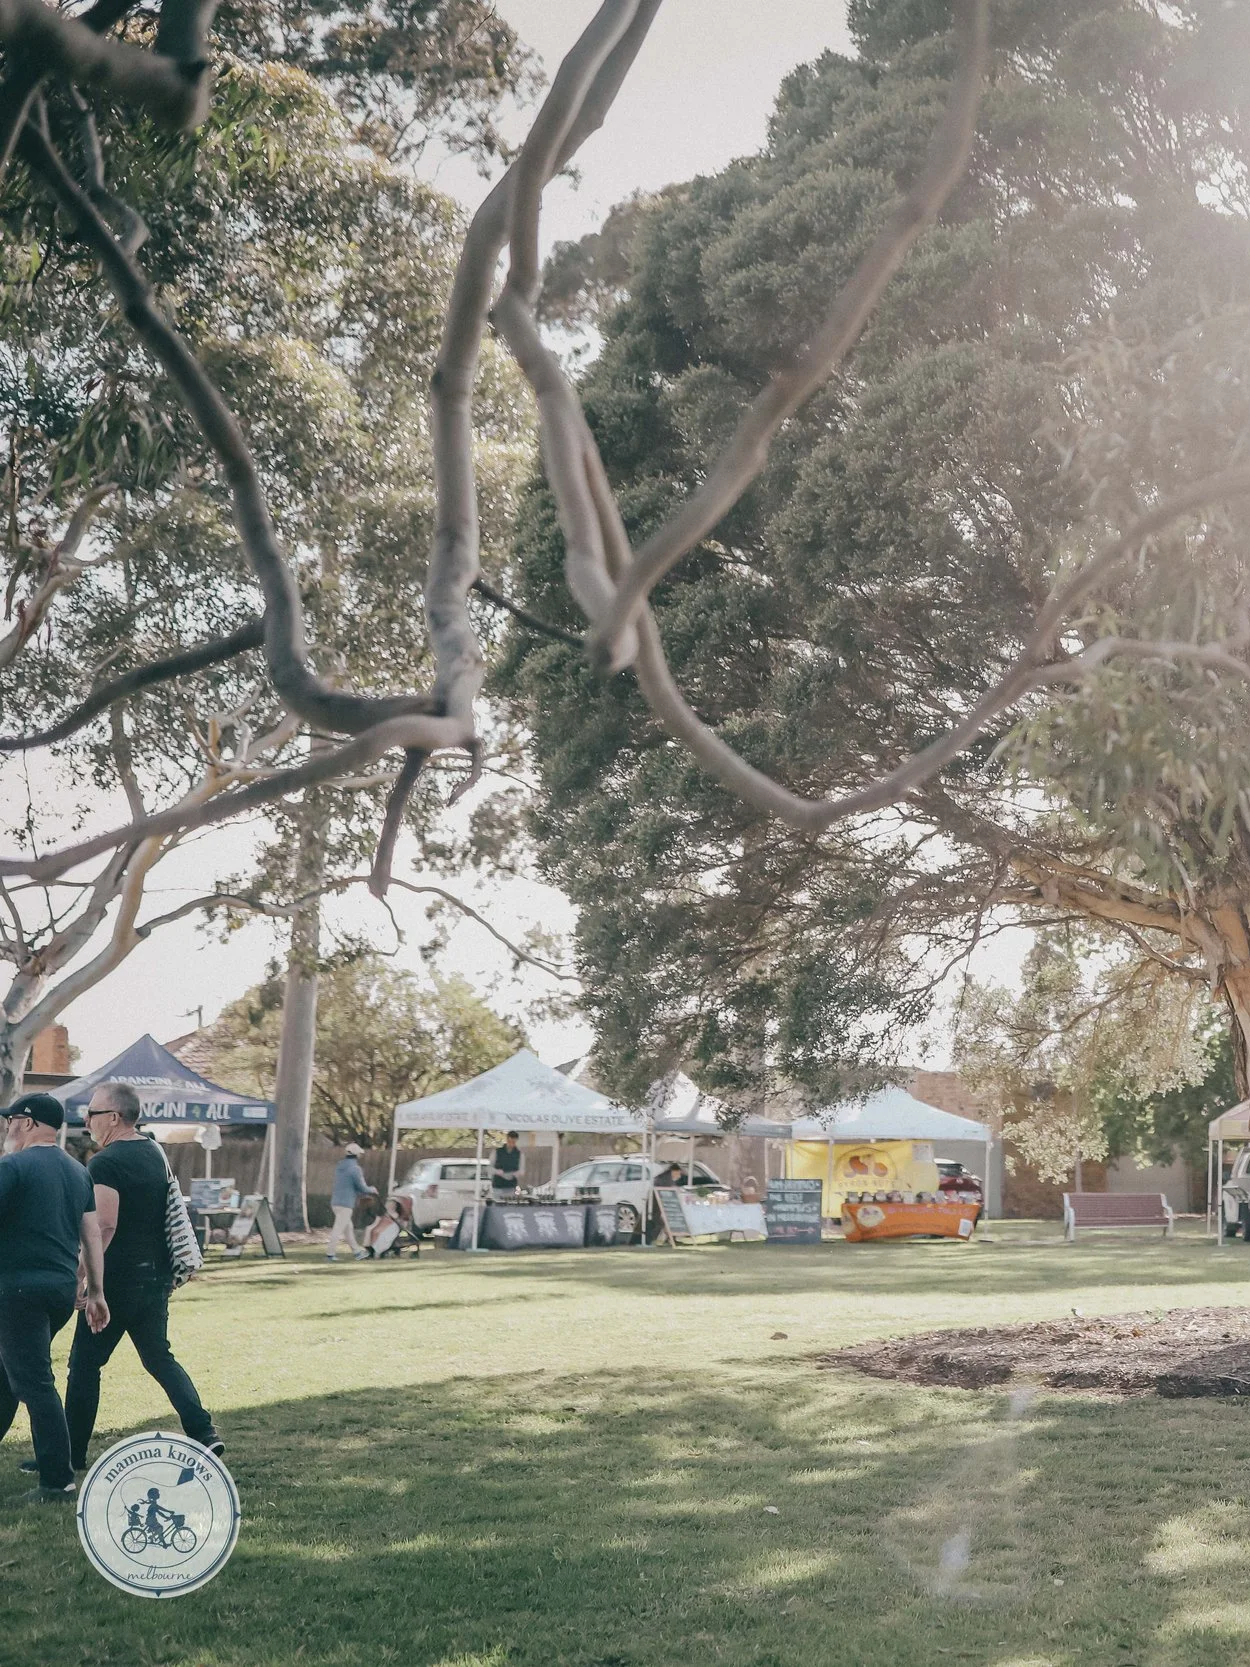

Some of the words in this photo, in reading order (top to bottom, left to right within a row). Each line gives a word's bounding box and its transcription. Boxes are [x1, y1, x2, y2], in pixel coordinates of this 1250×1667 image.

[139, 1102, 187, 1118] NCINI
[206, 1103, 231, 1120] ALL
[505, 1113, 549, 1124] NICOLAS
[552, 1114, 582, 1125] OLIVE
[584, 1115, 625, 1126] ESTATE
